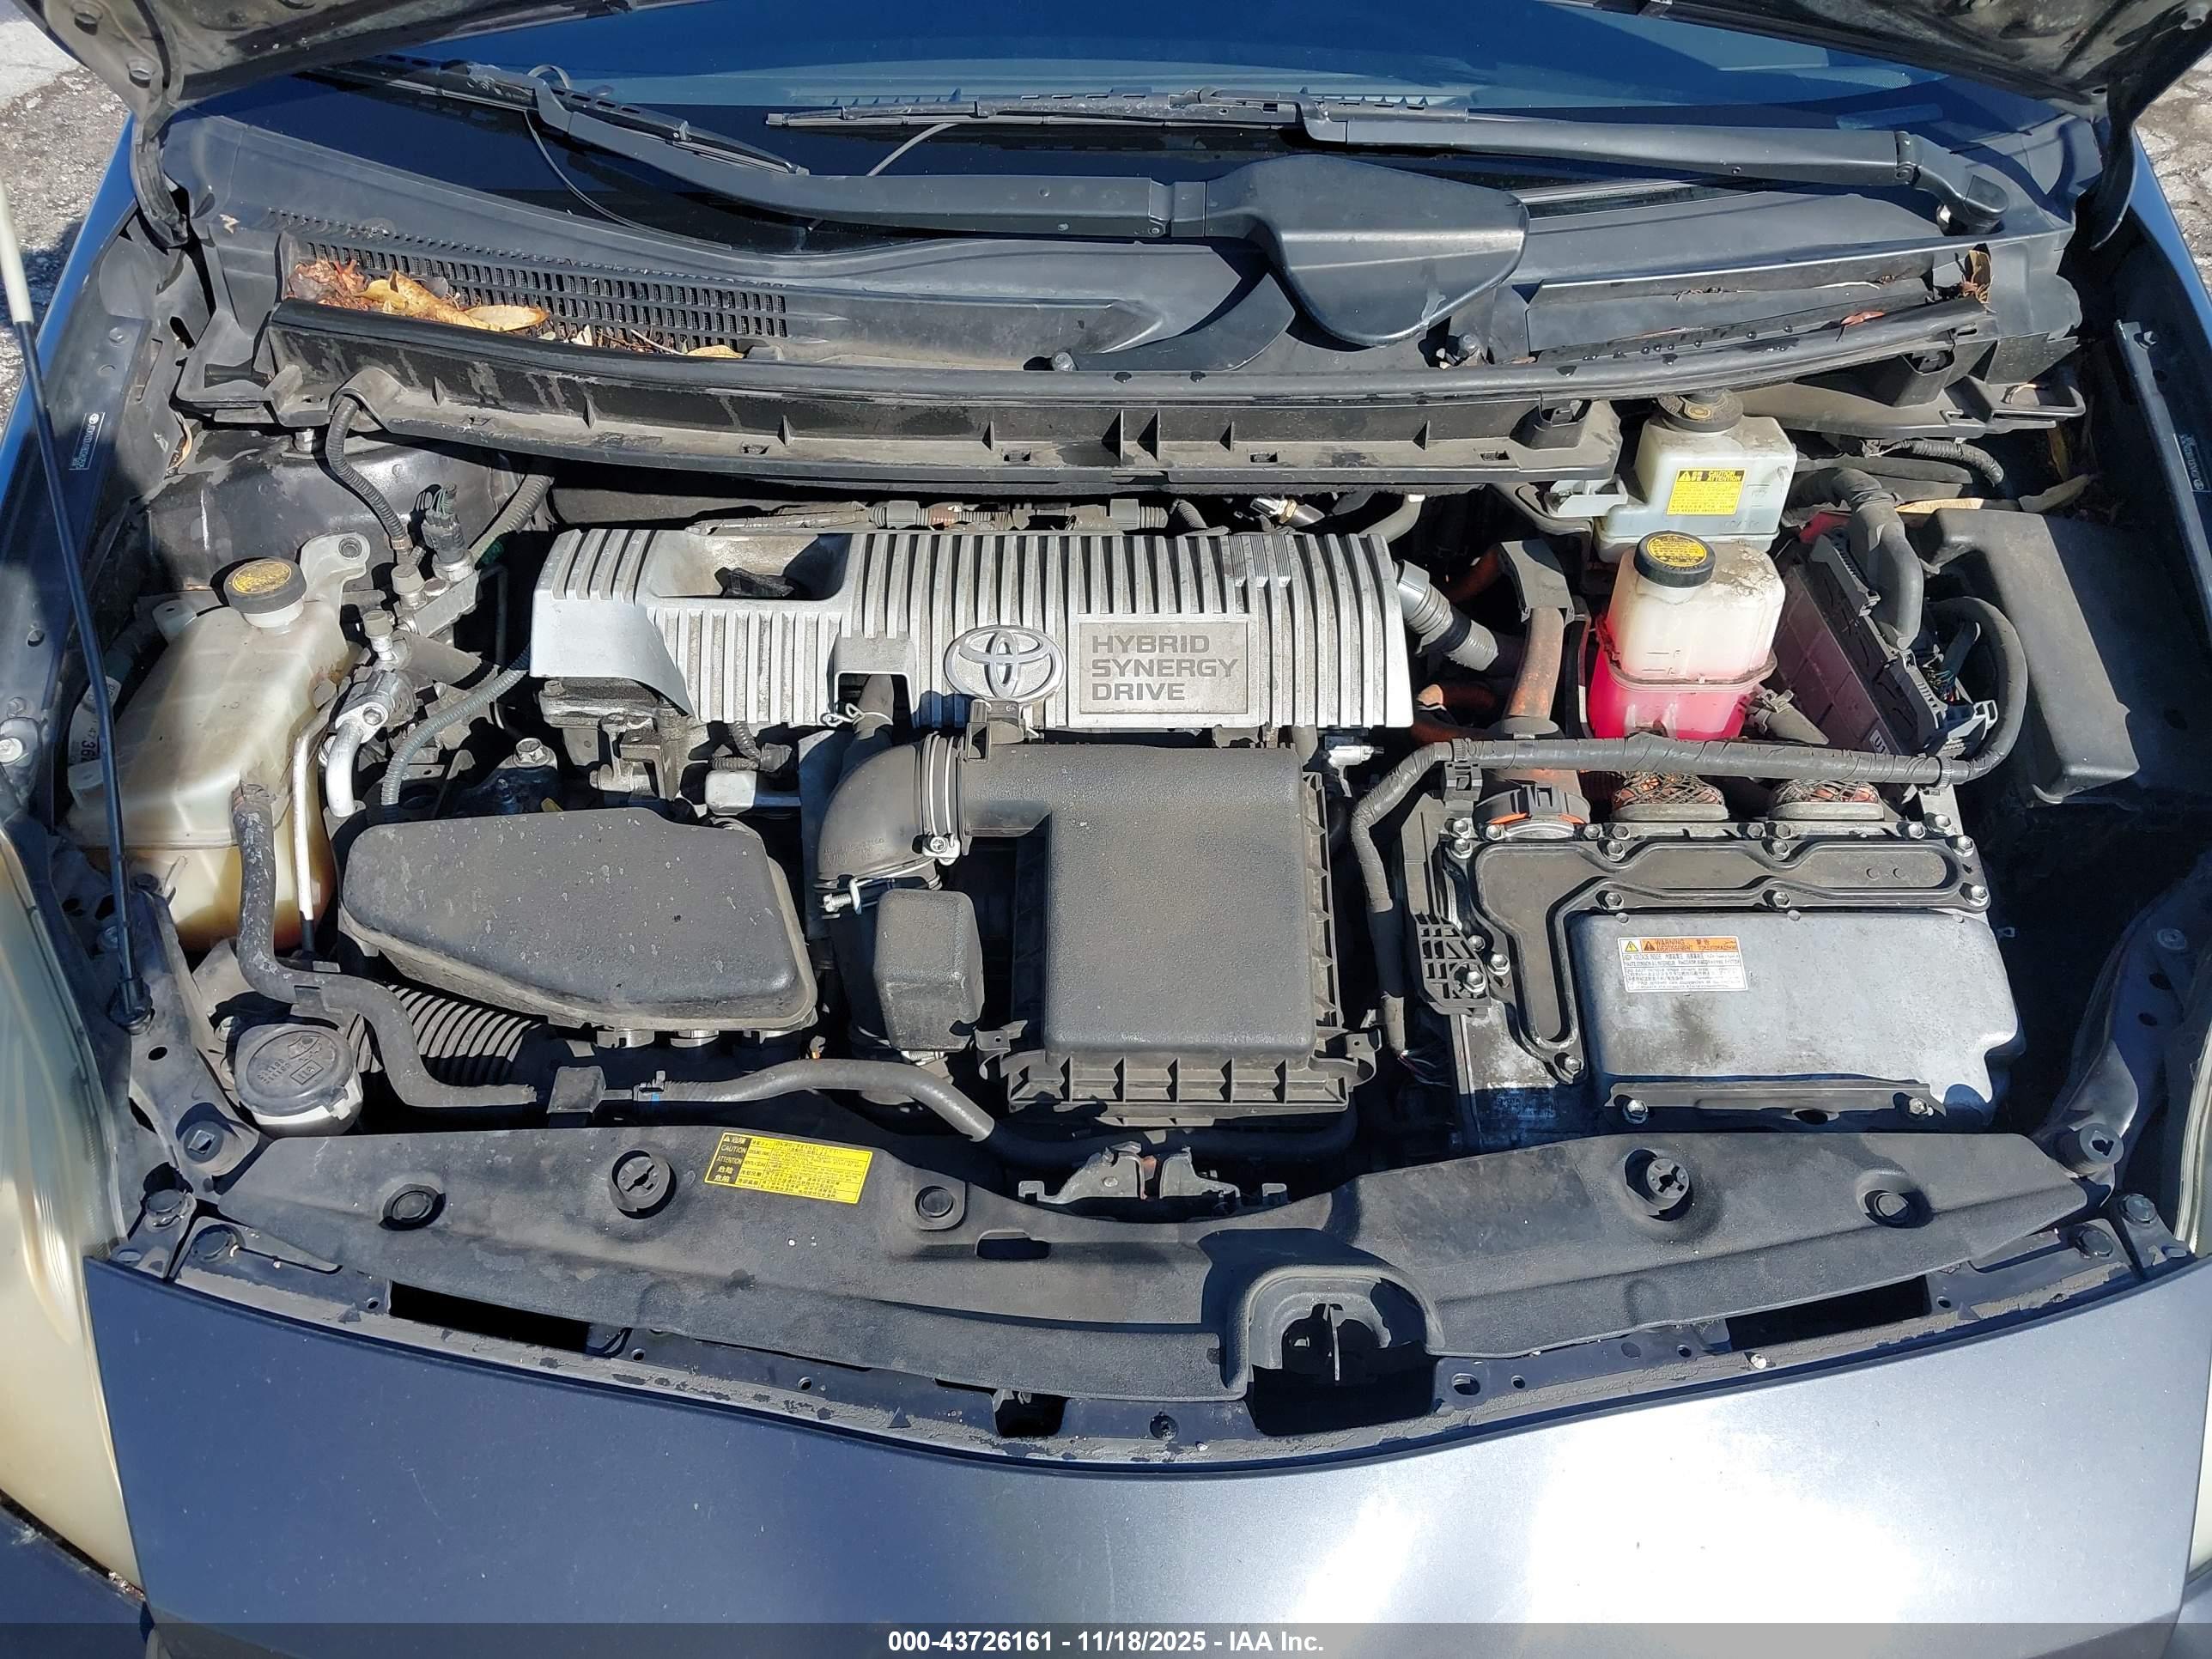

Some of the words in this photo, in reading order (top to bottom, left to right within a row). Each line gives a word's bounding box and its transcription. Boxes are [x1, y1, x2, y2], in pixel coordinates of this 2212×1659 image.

[1092, 635, 1210, 653] HYBRID
[1092, 659, 1238, 678] SYNERGY
[1092, 683, 1185, 701] DRIVE
[721, 1145, 747, 1153] CAUTION
[716, 1155, 743, 1164] ATTENTION
